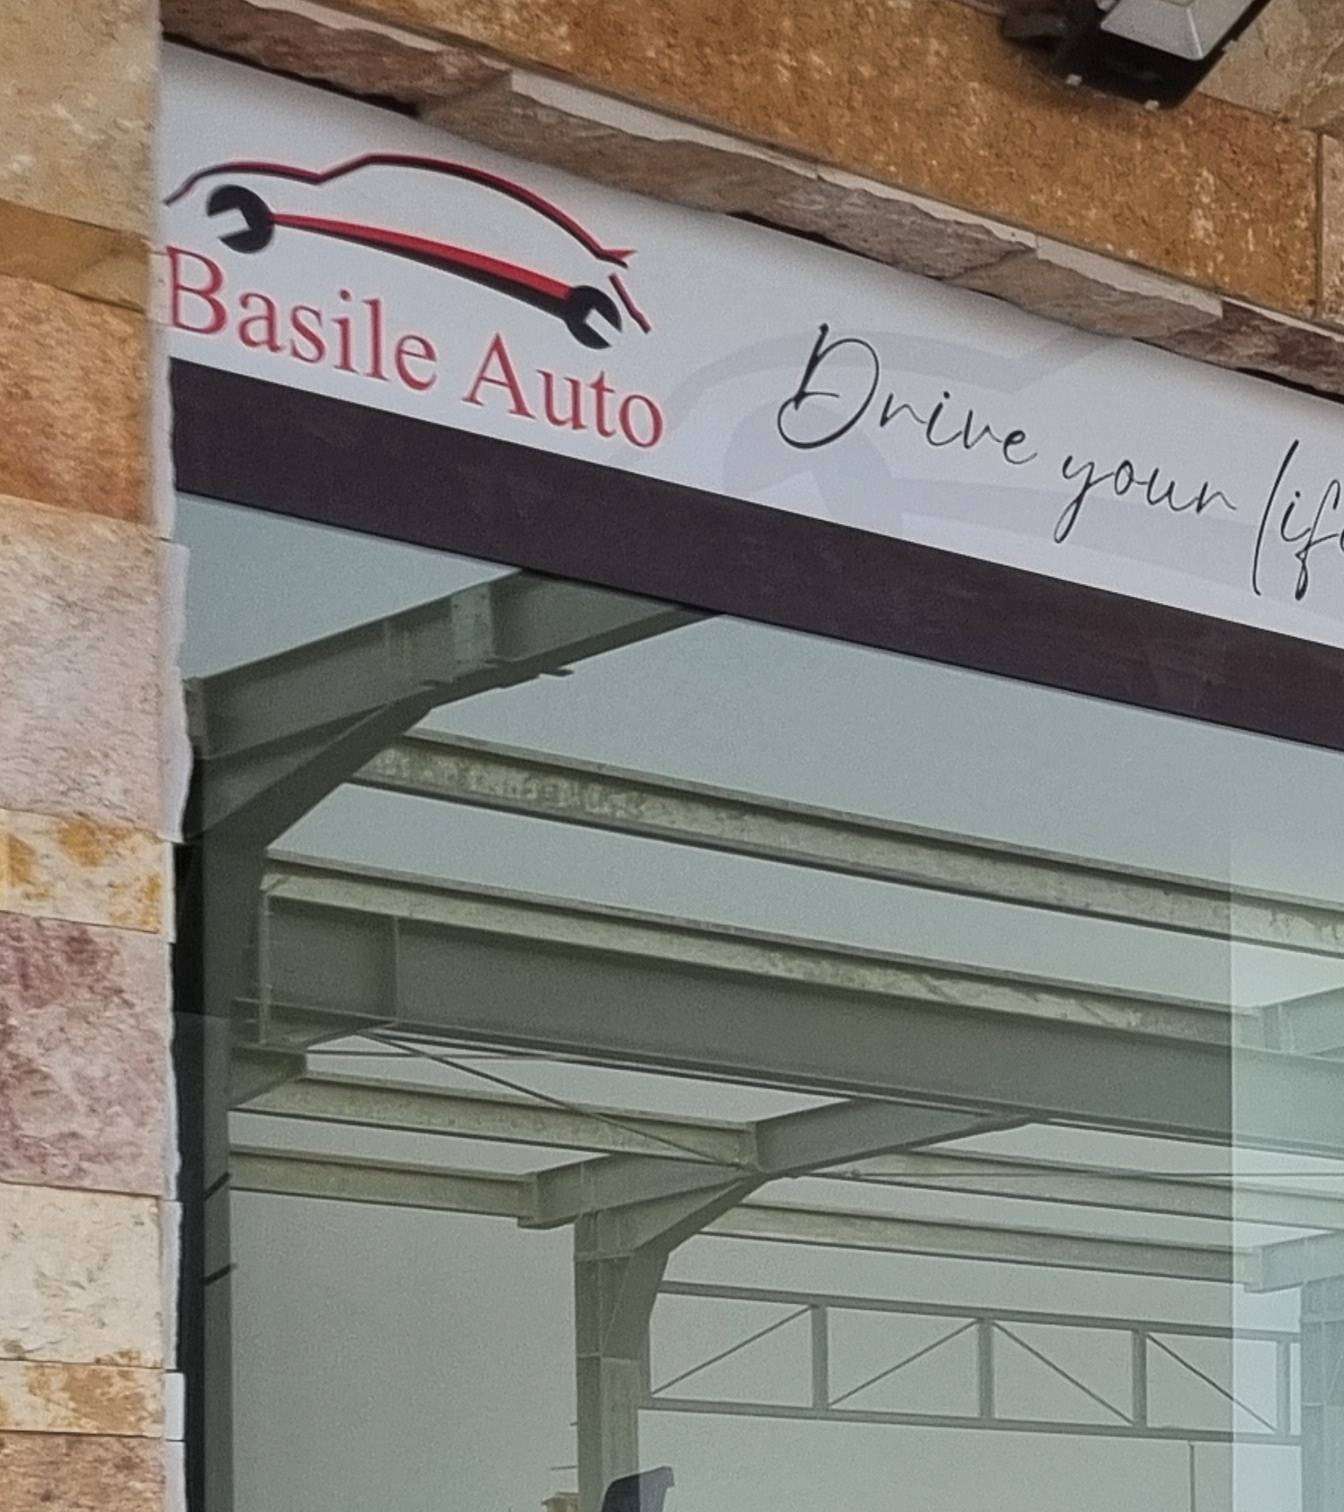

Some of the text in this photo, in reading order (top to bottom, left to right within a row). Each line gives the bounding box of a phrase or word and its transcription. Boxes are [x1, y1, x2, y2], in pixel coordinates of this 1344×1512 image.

[166, 246, 664, 448] Basile Auto
[776, 322, 1038, 466] Drive
[1061, 455, 1238, 543] your
